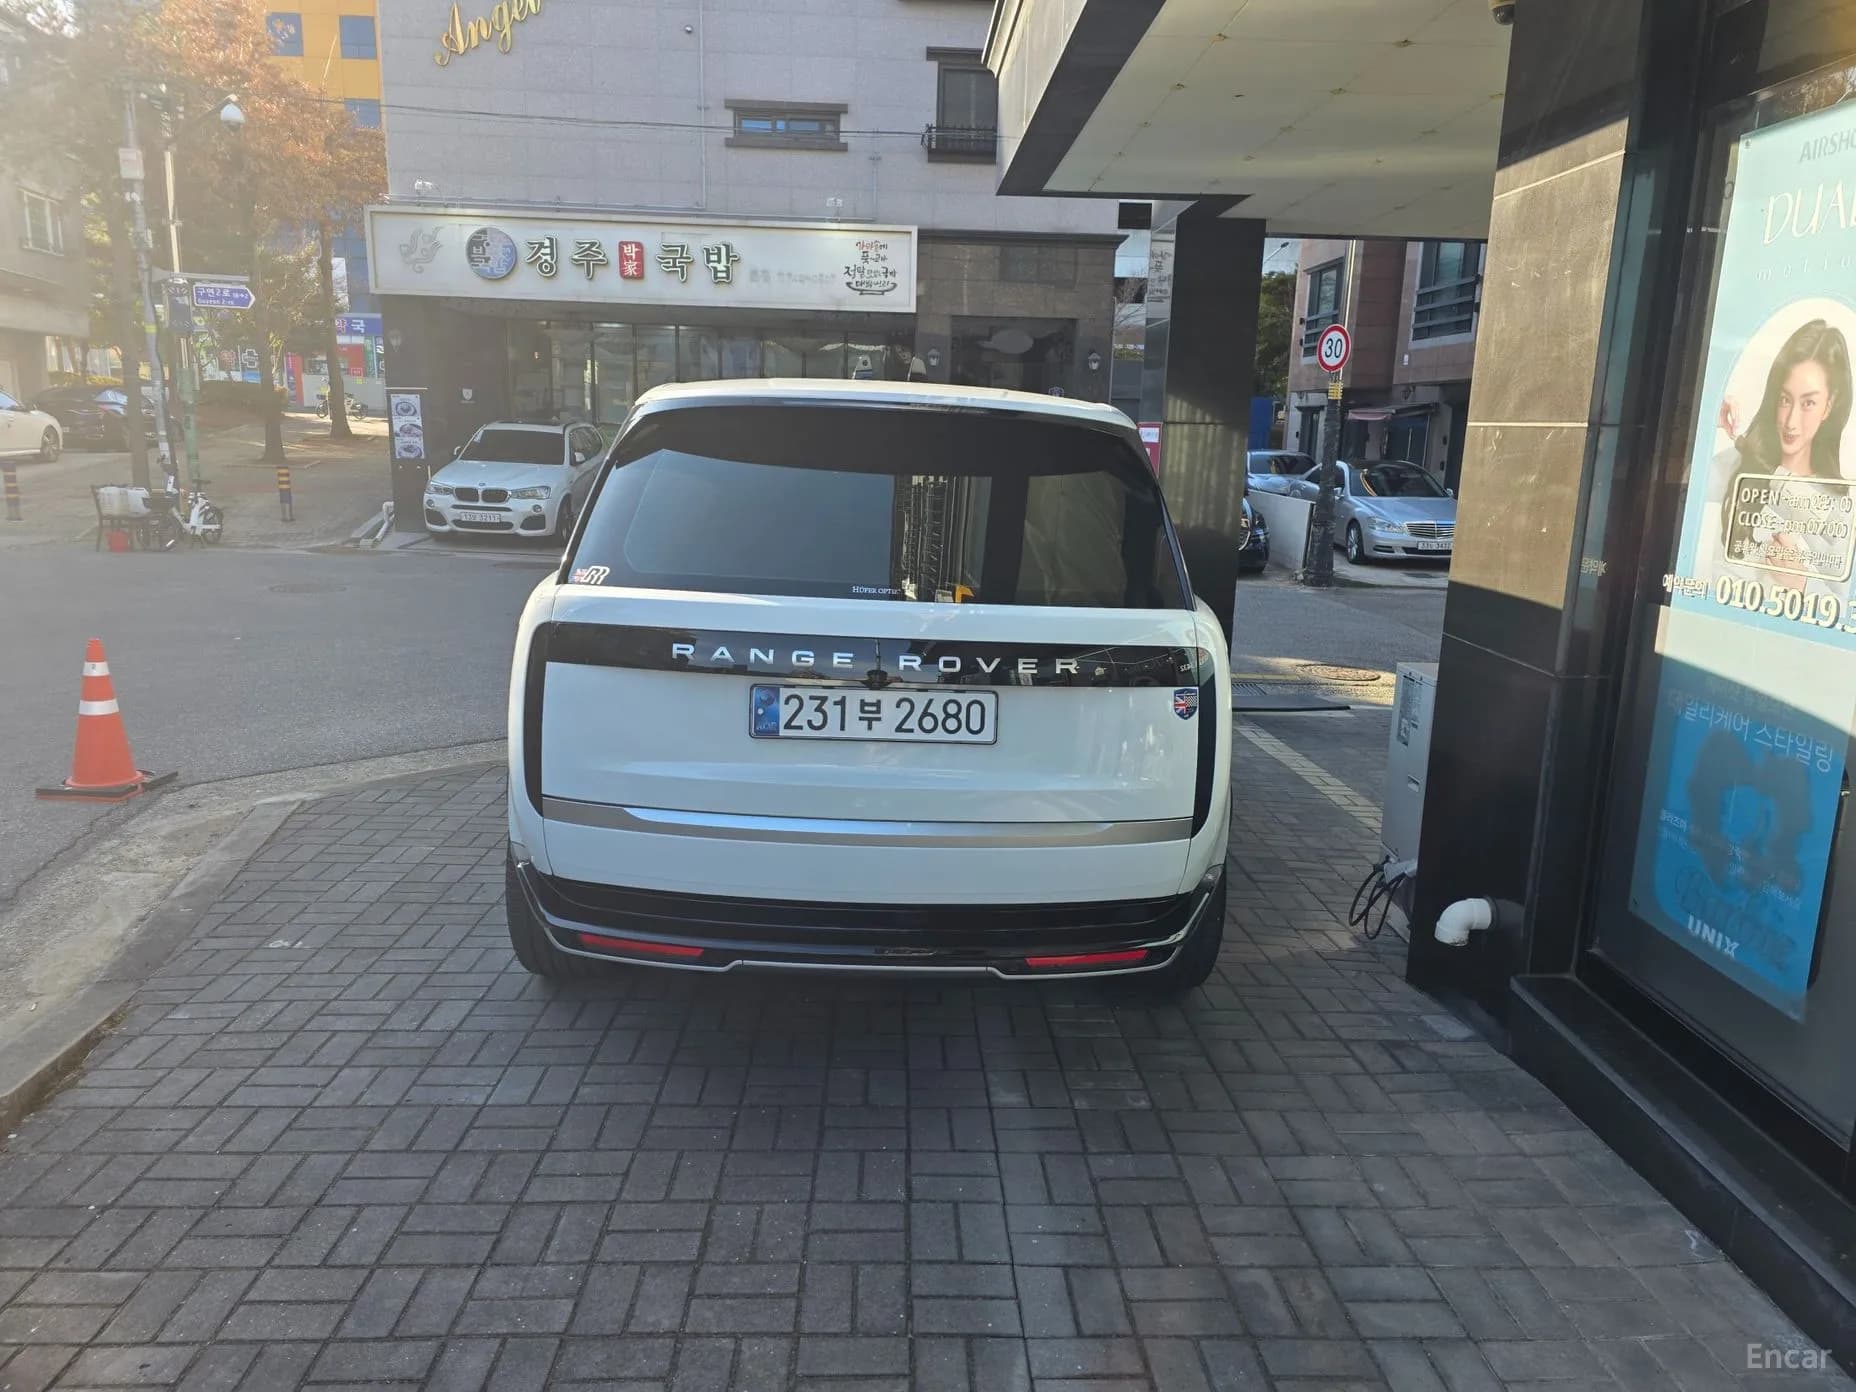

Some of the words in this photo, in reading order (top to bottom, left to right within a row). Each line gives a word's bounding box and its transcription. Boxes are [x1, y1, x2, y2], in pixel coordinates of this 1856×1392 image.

[434, 0, 541, 66] Ange
[525, 237, 608, 279] 경주
[656, 241, 740, 283] 국밥
[1325, 338, 1343, 358] 30
[1741, 487, 1780, 505] OPEN
[1738, 511, 1775, 530] CLOSE
[671, 643, 853, 669] RANGE
[899, 655, 1081, 675] ROVER
[783, 694, 882, 732] 231부
[895, 697, 986, 735] 2680
[1754, 720, 1834, 773] 스타일링
[1688, 914, 1740, 958] UNIX
